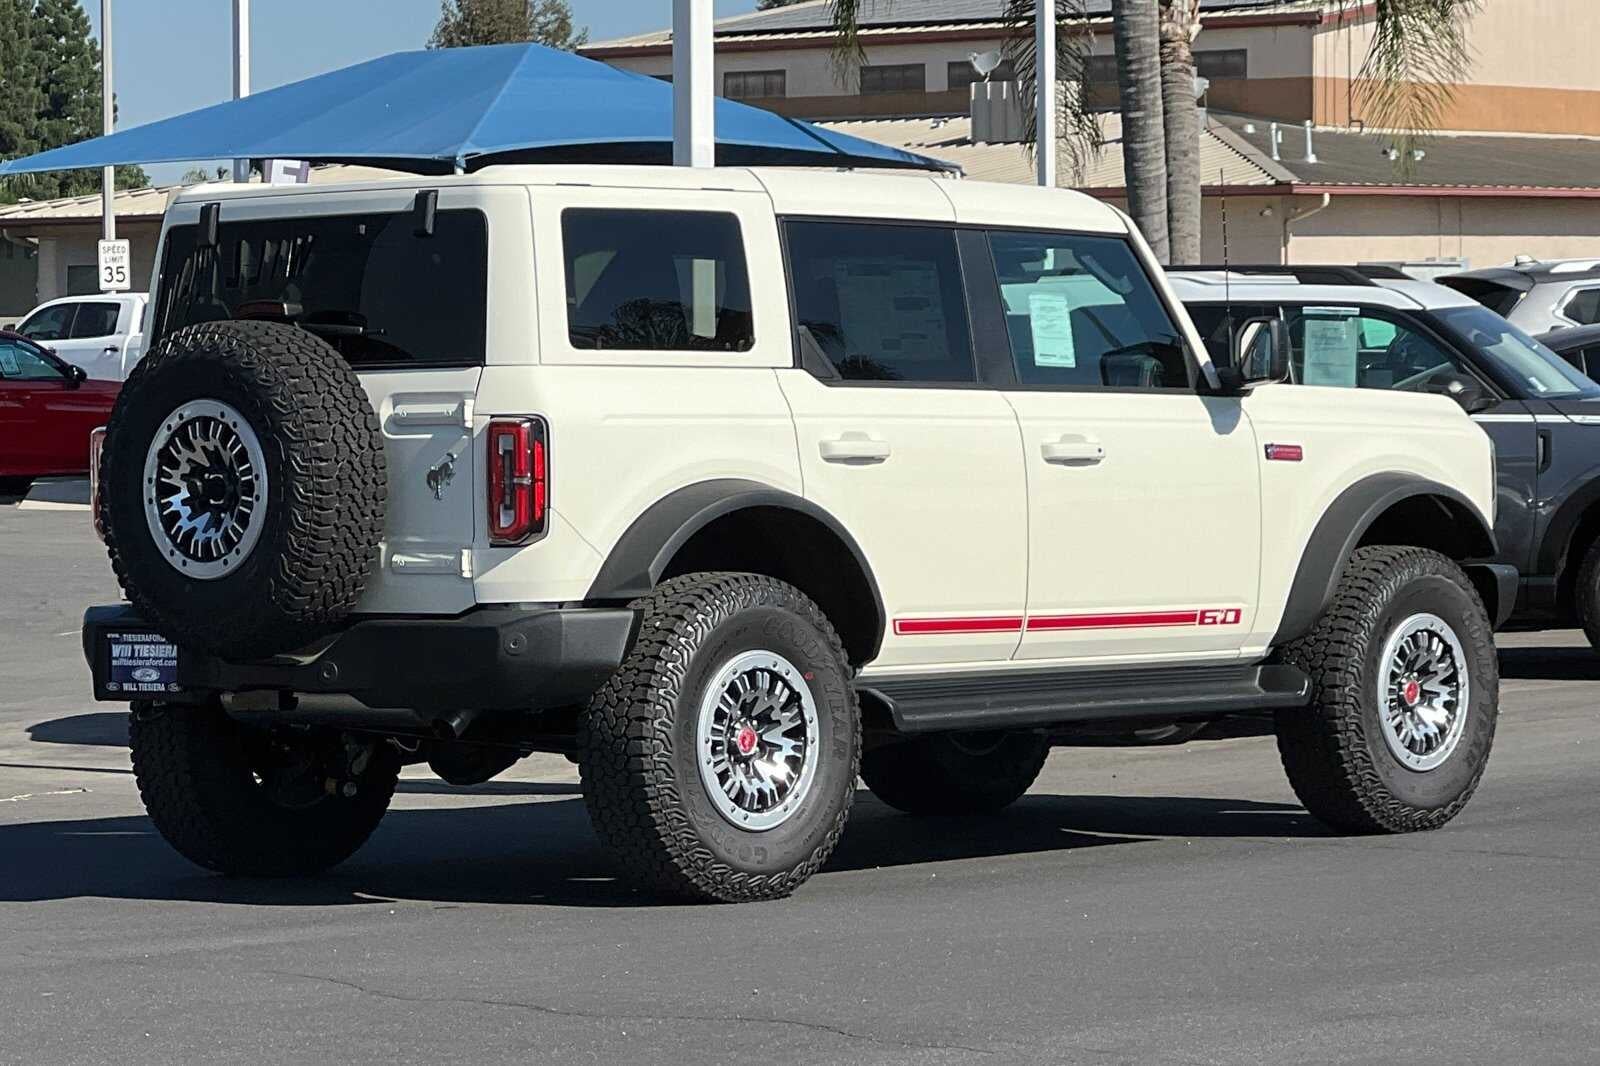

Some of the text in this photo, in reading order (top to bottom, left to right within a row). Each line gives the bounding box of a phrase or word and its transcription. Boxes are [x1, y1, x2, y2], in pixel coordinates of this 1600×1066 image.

[102, 246, 126, 254] SPEED
[104, 256, 124, 264] LIMIT
[104, 266, 126, 283] 35
[134, 644, 176, 657] TIESIERA
[123, 683, 137, 691] WILL
[138, 683, 165, 691] TIESIERA
